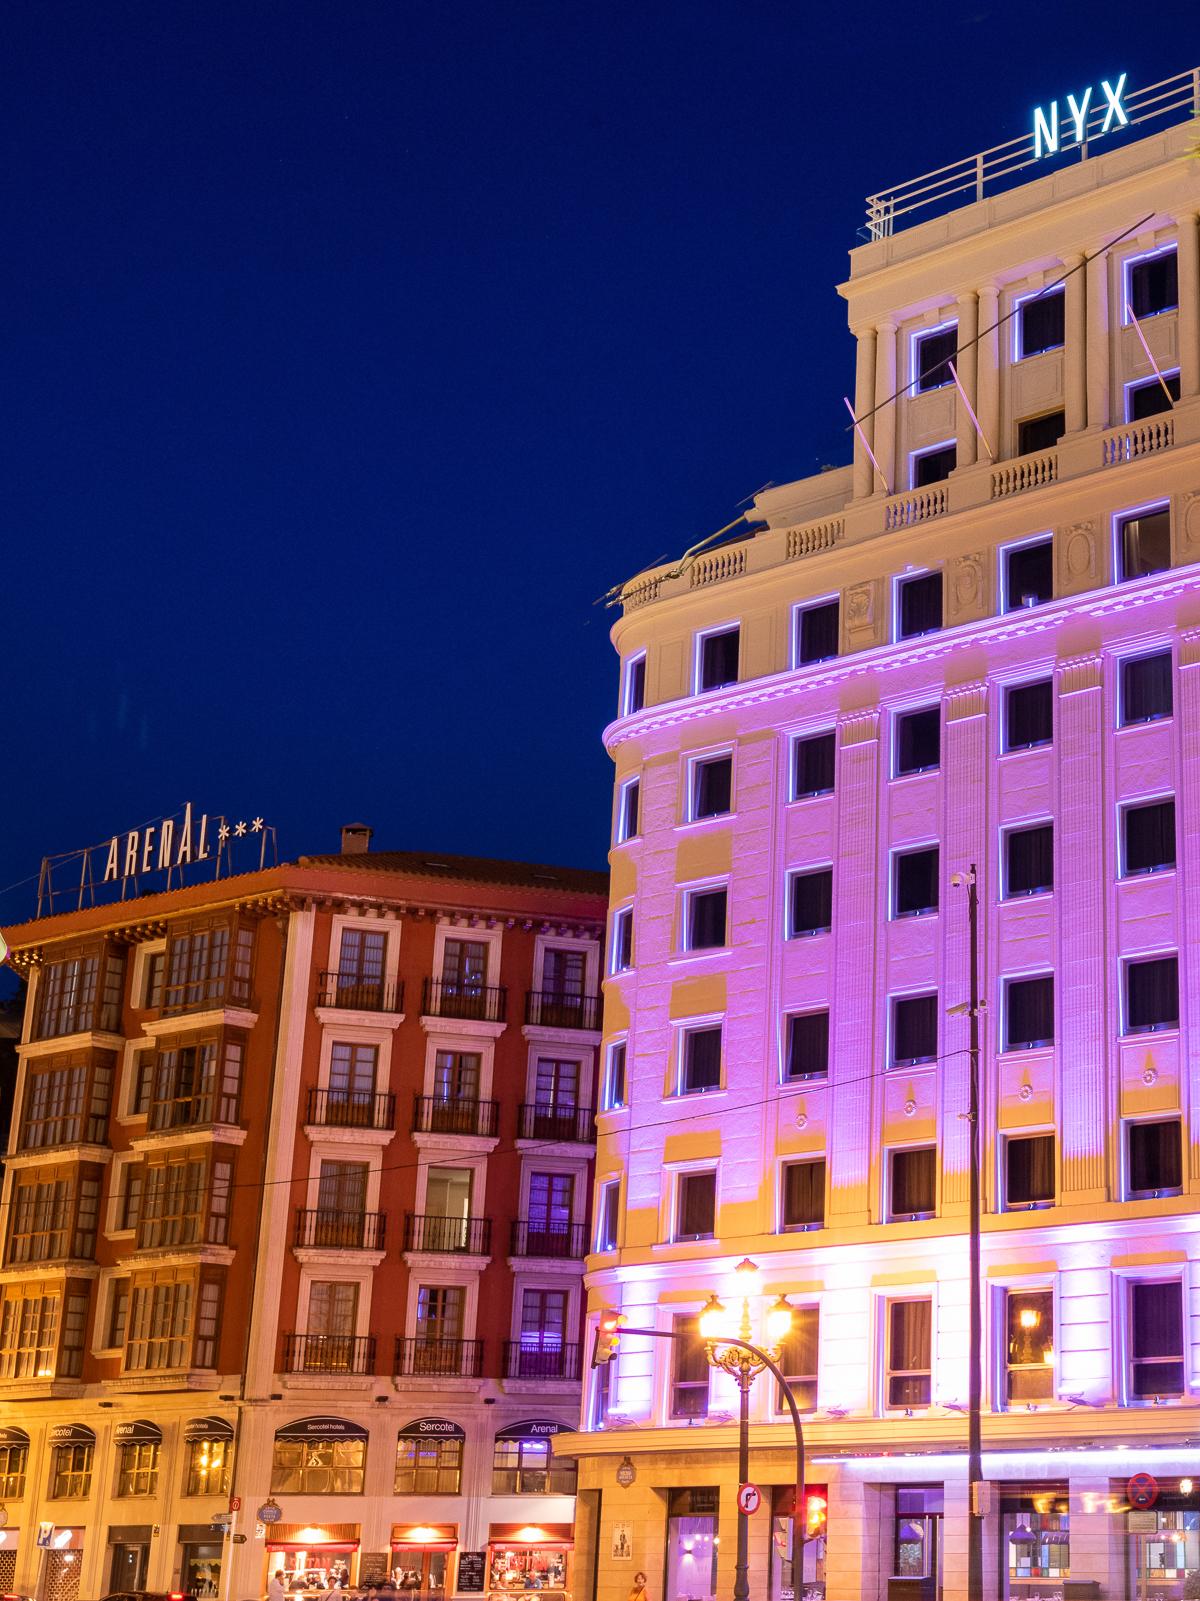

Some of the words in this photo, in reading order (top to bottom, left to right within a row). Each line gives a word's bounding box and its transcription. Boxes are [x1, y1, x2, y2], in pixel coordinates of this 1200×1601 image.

[1033, 72, 1130, 158] NYX
[104, 801, 210, 881] ARENAL
[419, 1421, 455, 1432] Sercotel
[531, 1424, 558, 1433] Arenal
